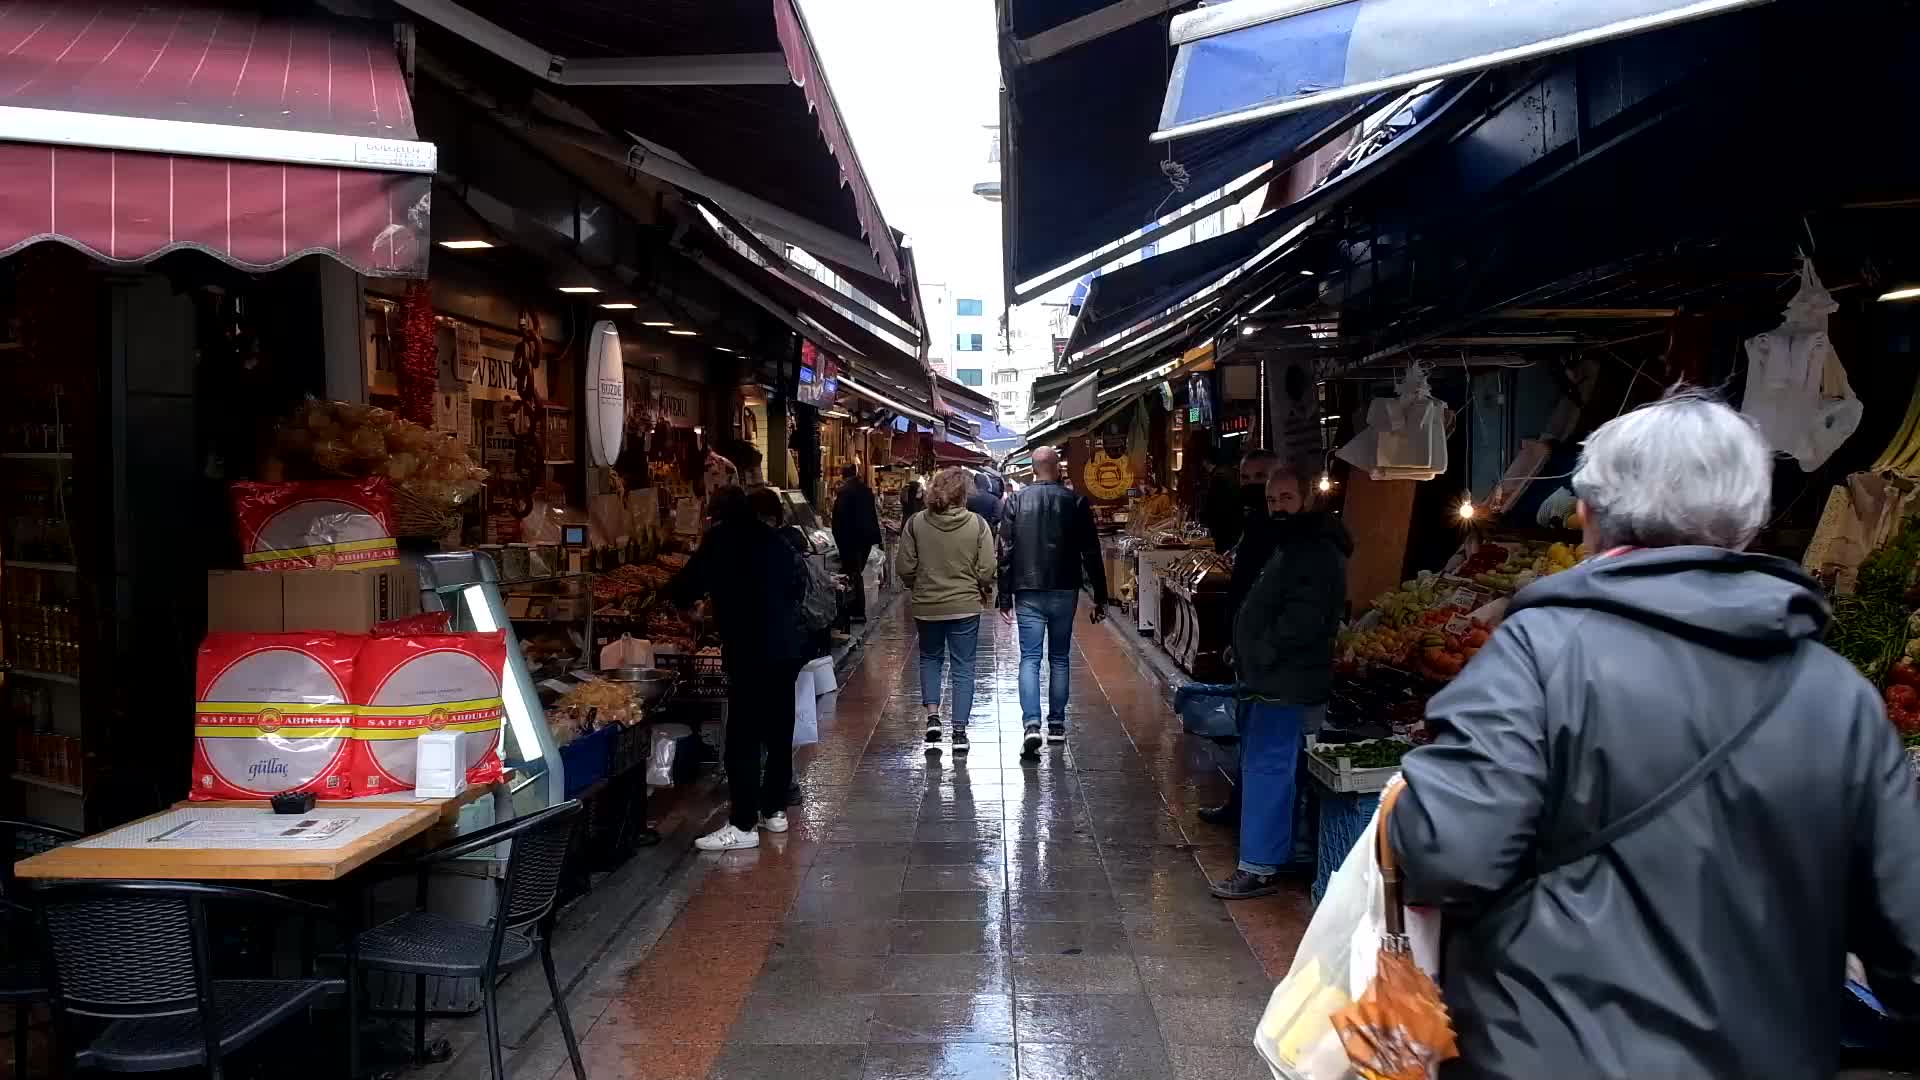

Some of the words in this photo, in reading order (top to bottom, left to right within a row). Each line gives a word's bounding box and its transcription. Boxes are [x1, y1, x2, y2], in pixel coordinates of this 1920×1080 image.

[200, 714, 255, 725] SAFFET
[285, 715, 351, 726] ABDULLAH
[368, 717, 424, 728] SAFFET
[449, 709, 501, 723] ABDULLAH
[248, 757, 289, 781] güllaç
